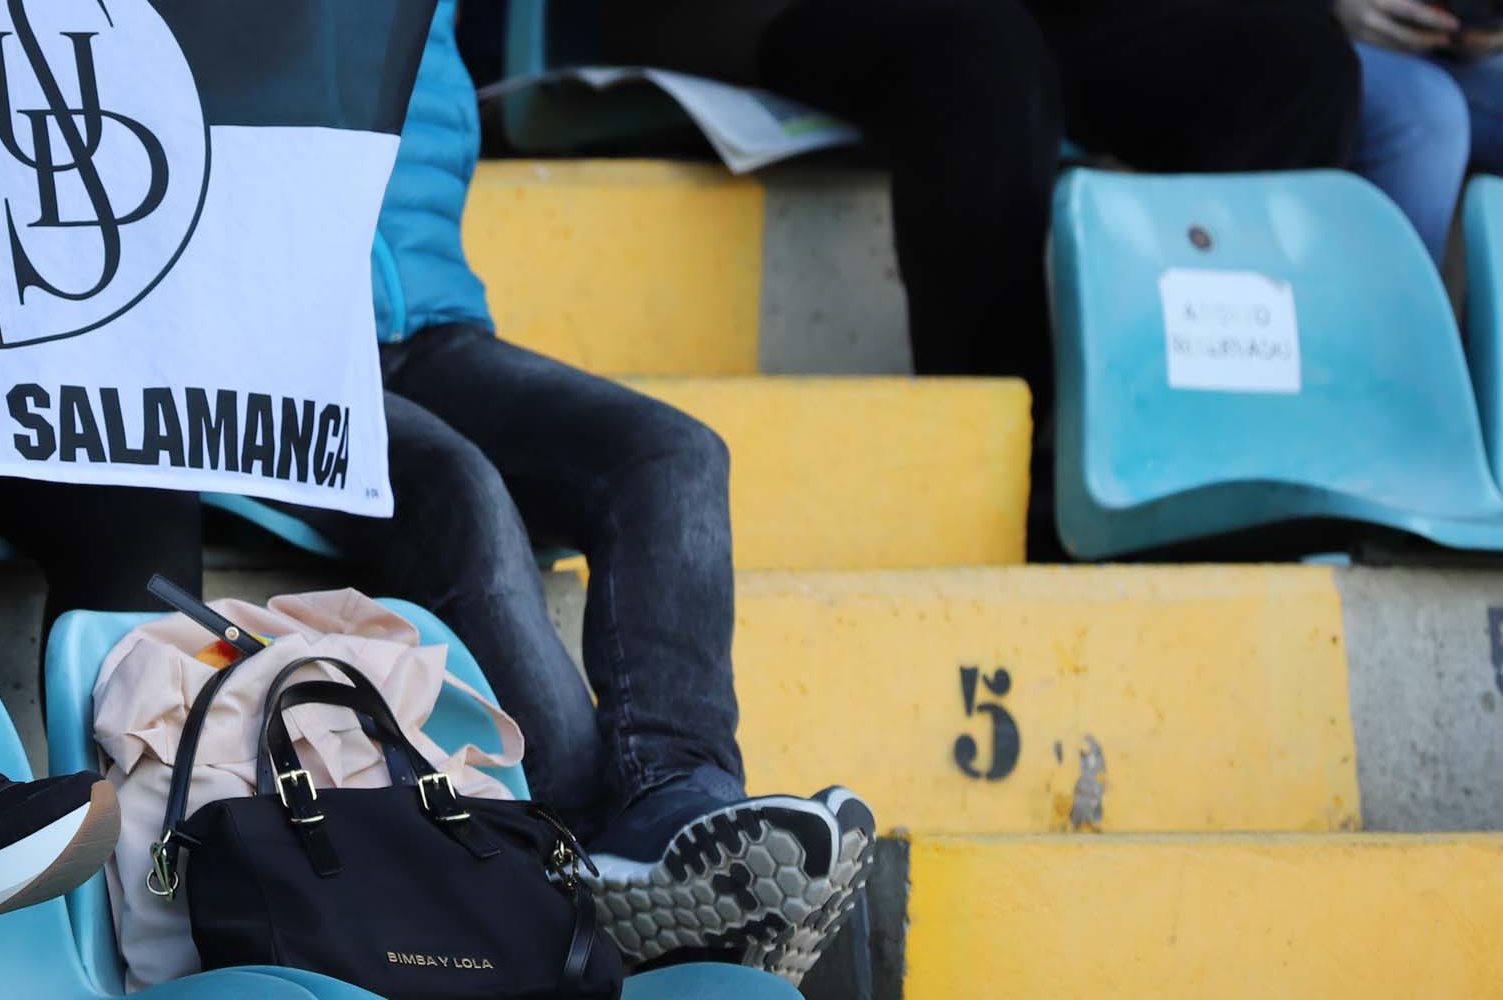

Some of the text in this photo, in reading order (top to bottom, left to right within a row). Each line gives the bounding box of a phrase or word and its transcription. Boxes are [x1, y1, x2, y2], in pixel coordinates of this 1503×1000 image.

[6, 383, 350, 490] SALAMANCA
[954, 665, 1021, 782] 5
[453, 957, 494, 969] LOLA
